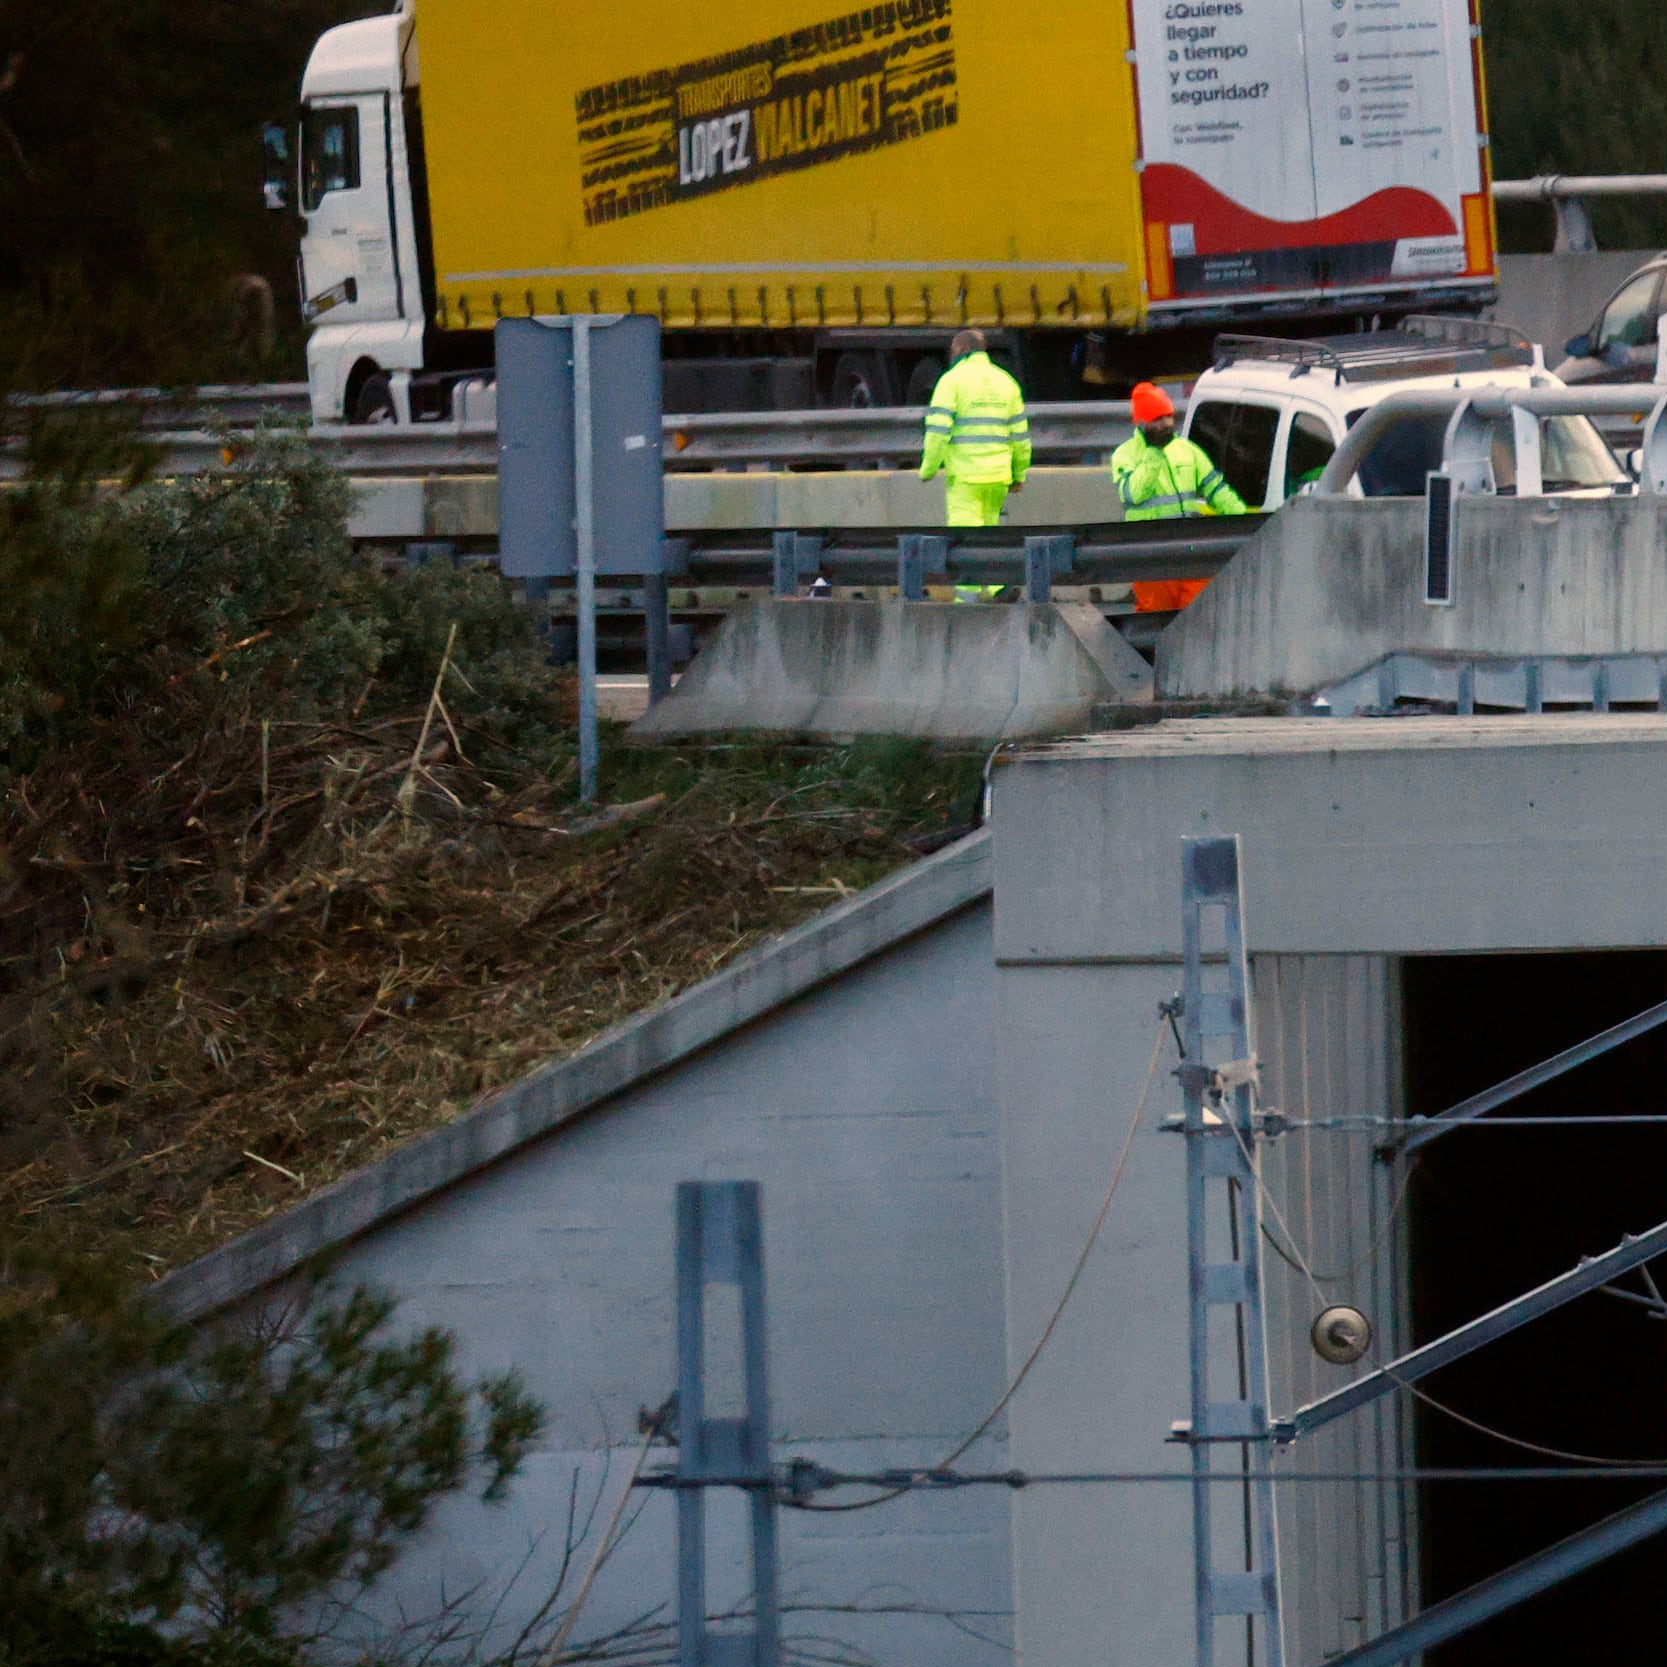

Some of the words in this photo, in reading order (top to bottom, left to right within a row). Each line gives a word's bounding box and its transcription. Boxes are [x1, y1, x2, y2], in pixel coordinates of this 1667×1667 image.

[1165, 2, 1244, 19] ¿Quieres
[1167, 25, 1217, 42] llegar
[1168, 50, 1179, 62] a
[1184, 44, 1248, 60] tiempo
[1170, 70, 1180, 86] y
[1185, 67, 1218, 82] con
[1171, 82, 1269, 106] seguridad?
[679, 109, 751, 185] LOPEZ
